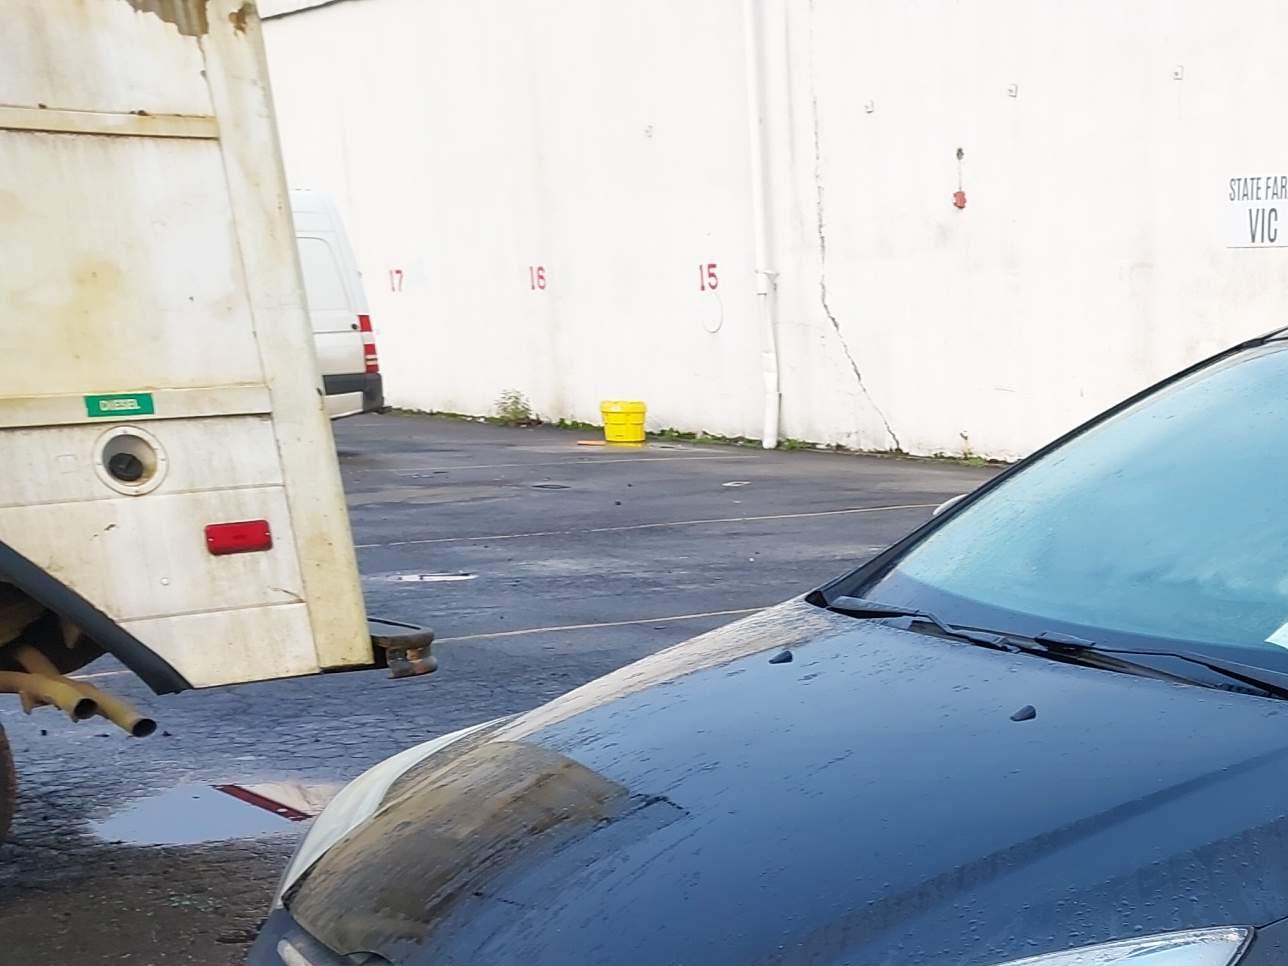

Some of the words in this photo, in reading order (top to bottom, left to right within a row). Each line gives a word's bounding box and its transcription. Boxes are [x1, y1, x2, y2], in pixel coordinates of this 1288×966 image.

[1229, 177, 1262, 201] STATE
[1248, 207, 1278, 243] VIC
[388, 268, 404, 293] 17
[528, 265, 546, 291] 16
[698, 263, 719, 291] 15
